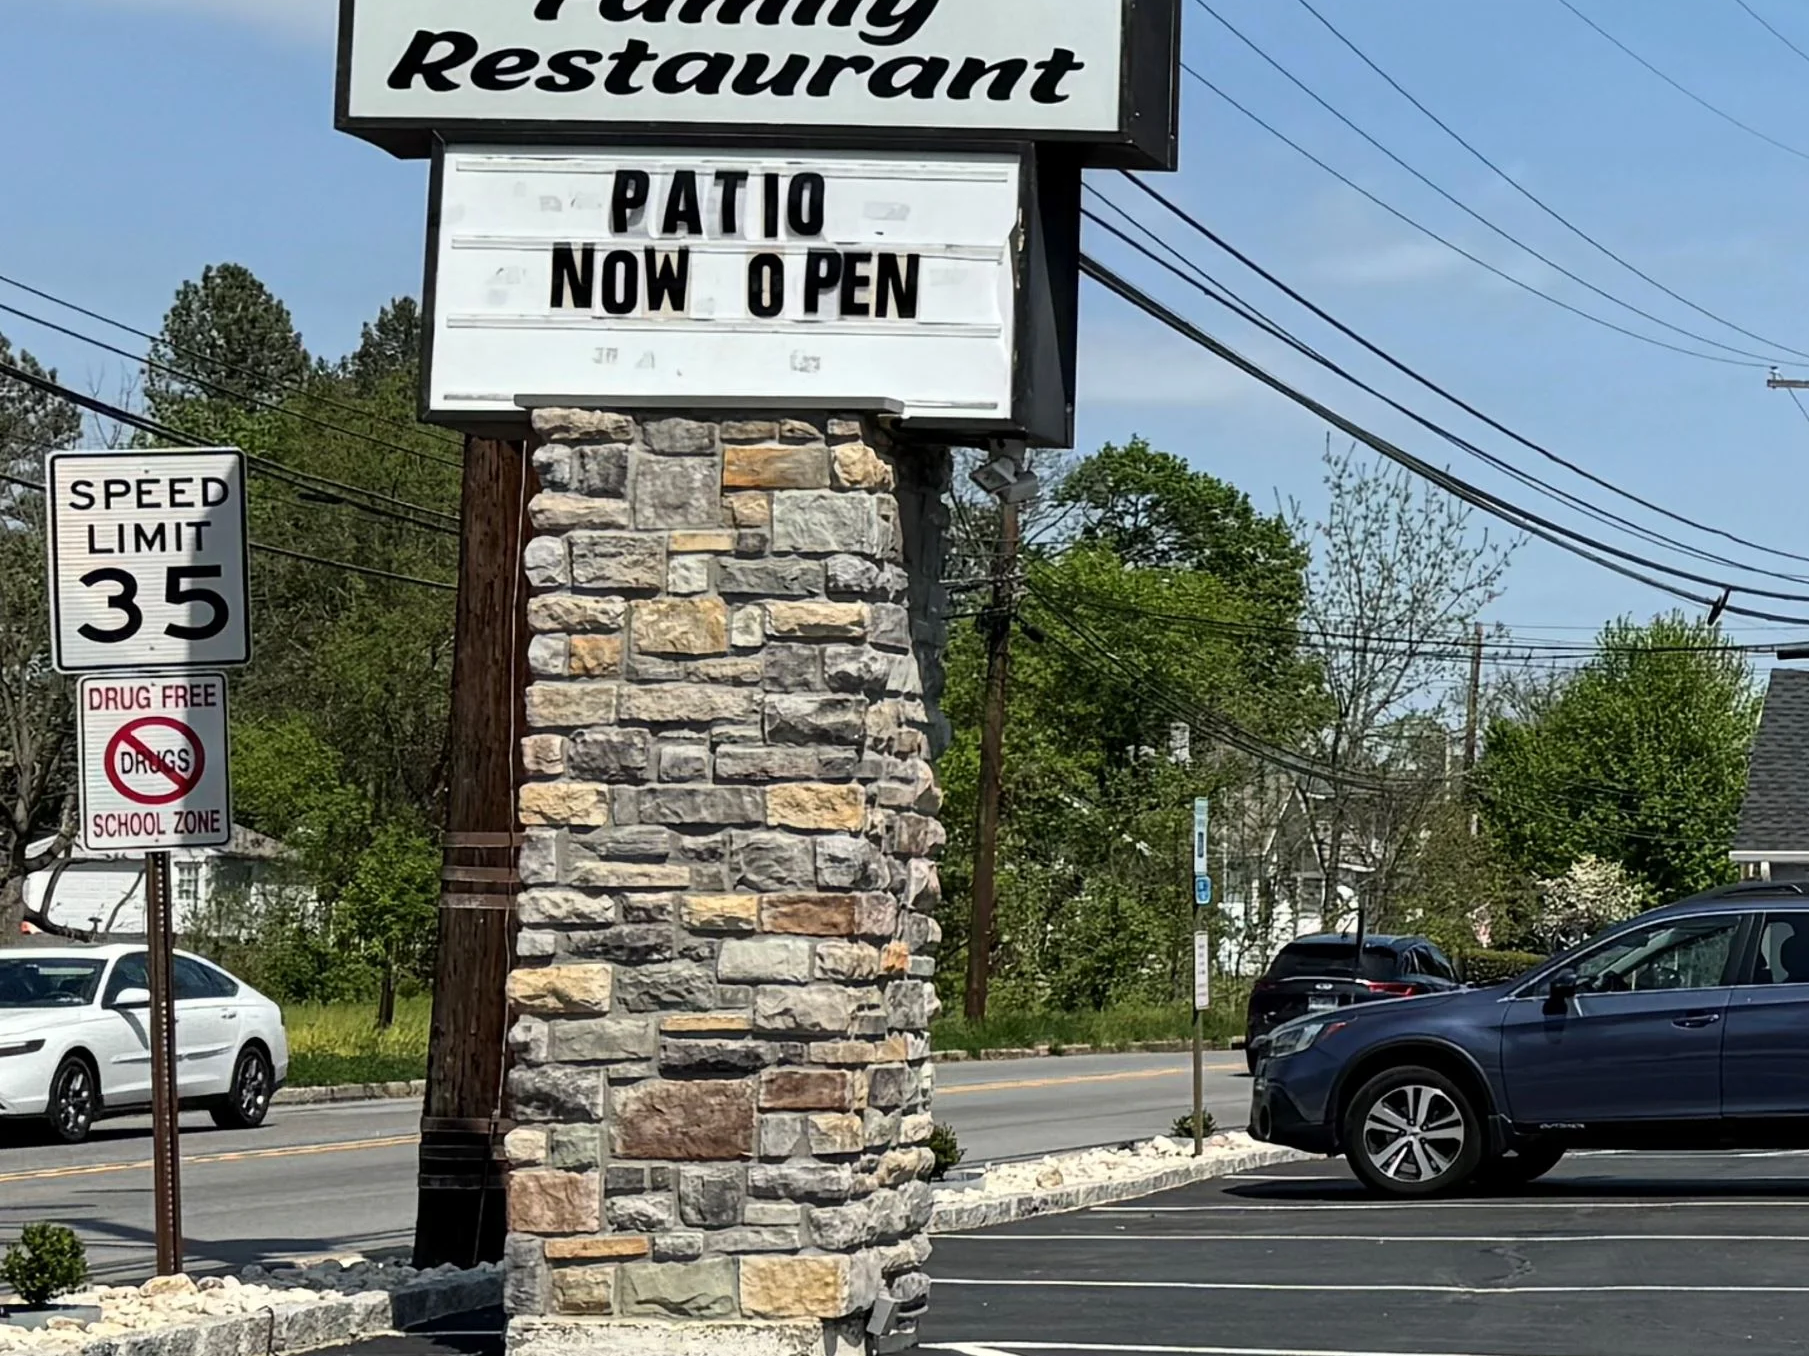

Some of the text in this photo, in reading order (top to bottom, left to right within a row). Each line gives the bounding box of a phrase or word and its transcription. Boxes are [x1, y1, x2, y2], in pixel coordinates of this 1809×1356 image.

[387, 30, 1085, 105] Restaurant
[611, 169, 825, 240] PATIO
[550, 242, 921, 319] NOW OPEN
[69, 477, 230, 511] SPEED
[87, 519, 213, 555] LIMIT
[77, 563, 230, 644] 35
[88, 683, 217, 710] DRUG FREE
[120, 747, 190, 775] DRUGS
[93, 809, 221, 838] SCHOOL ZONE
